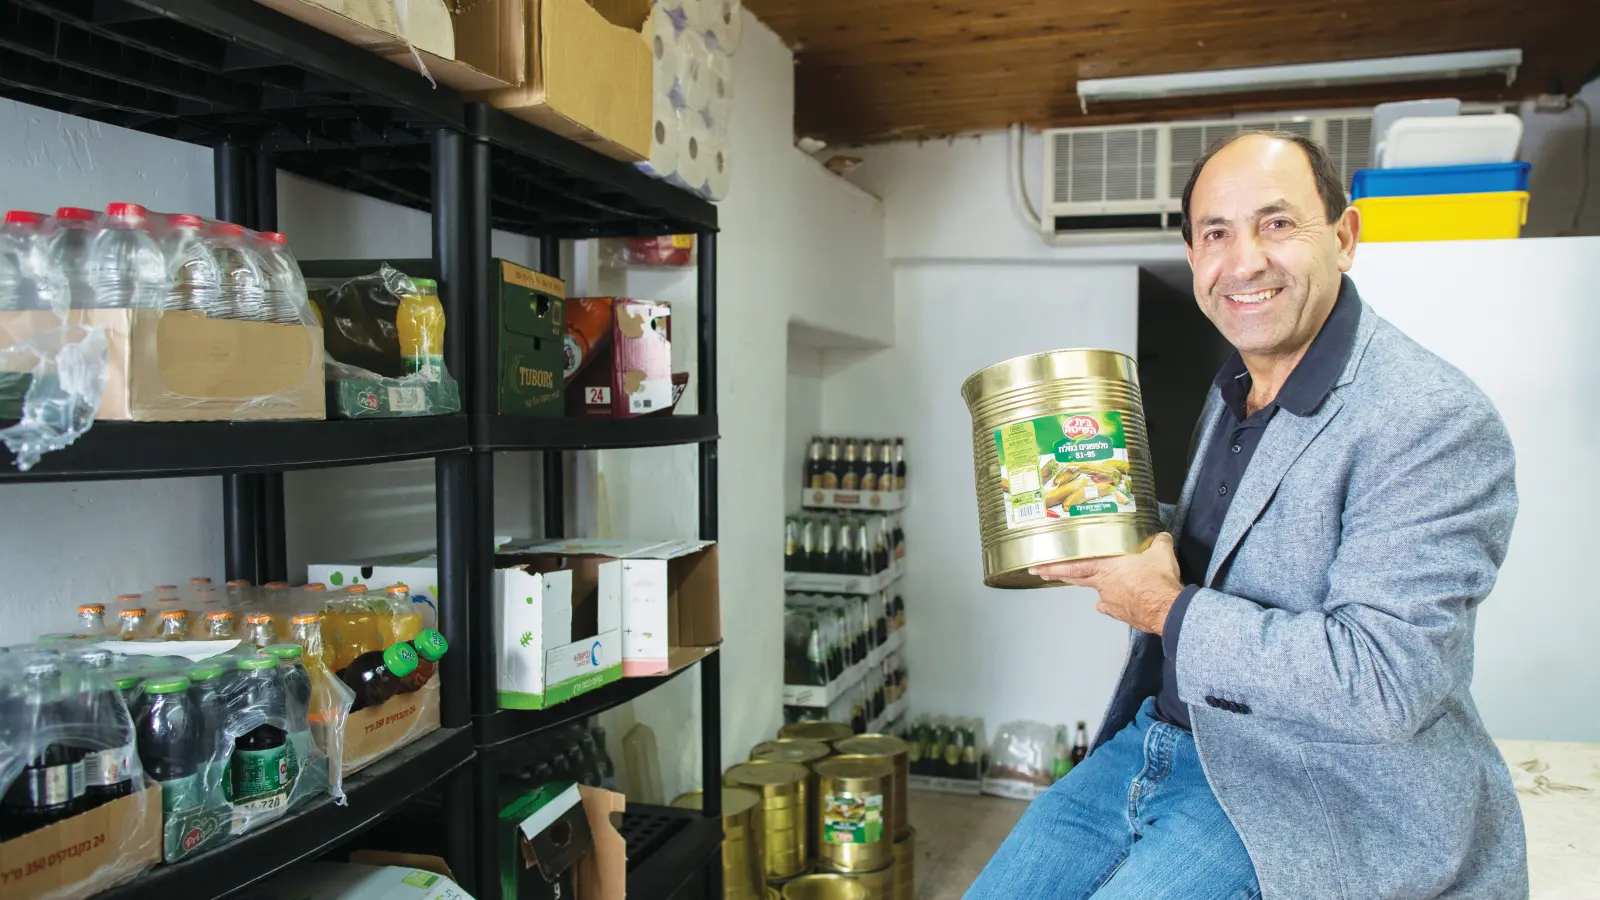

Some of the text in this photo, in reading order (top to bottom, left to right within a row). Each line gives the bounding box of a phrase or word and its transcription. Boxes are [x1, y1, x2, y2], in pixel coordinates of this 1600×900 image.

[519, 366, 553, 389] TUBORG
[590, 388, 604, 403] 24
[1074, 418, 1094, 428] בית
[1063, 425, 1097, 436] השיטה
[1058, 441, 1109, 454] מלפפונים במלח
[1075, 451, 1096, 459] 81-95
[385, 709, 410, 724] בקבוקים
[409, 705, 416, 715] 24
[374, 718, 385, 730] 350
[93, 833, 105, 848] 24
[48, 840, 92, 867] בקבוקים
[25, 857, 46, 876] 350
